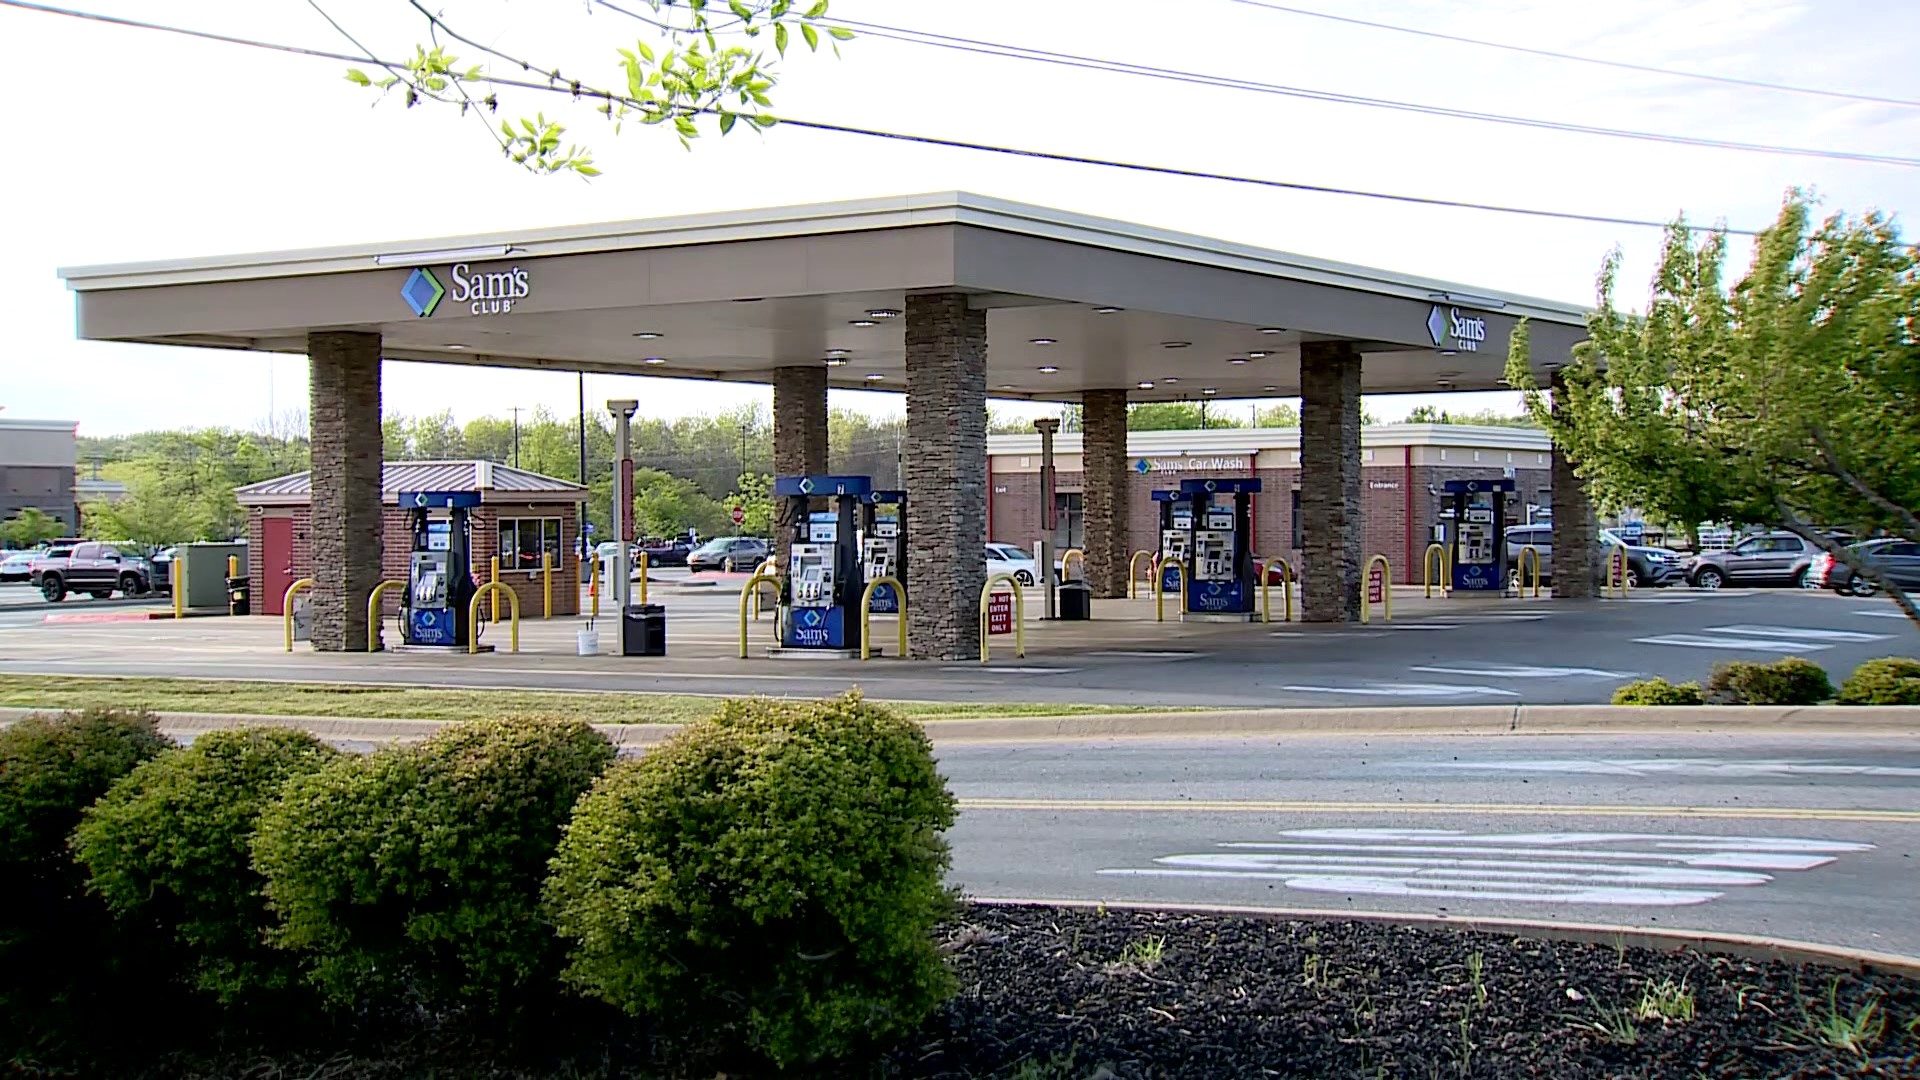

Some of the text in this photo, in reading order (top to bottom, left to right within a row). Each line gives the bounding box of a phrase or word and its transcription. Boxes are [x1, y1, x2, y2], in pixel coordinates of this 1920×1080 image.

[452, 263, 529, 301] Sam's
[471, 302, 511, 315] CLUB
[1450, 307, 1485, 341] Sam's
[1188, 458, 1208, 470] Car
[1211, 457, 1243, 469] Wash
[1369, 481, 1399, 489] Entrance
[990, 604, 1009, 613] ENTER
[991, 614, 1007, 622] EXIT
[796, 624, 829, 641] Sams
[991, 624, 1007, 632] ONLY
